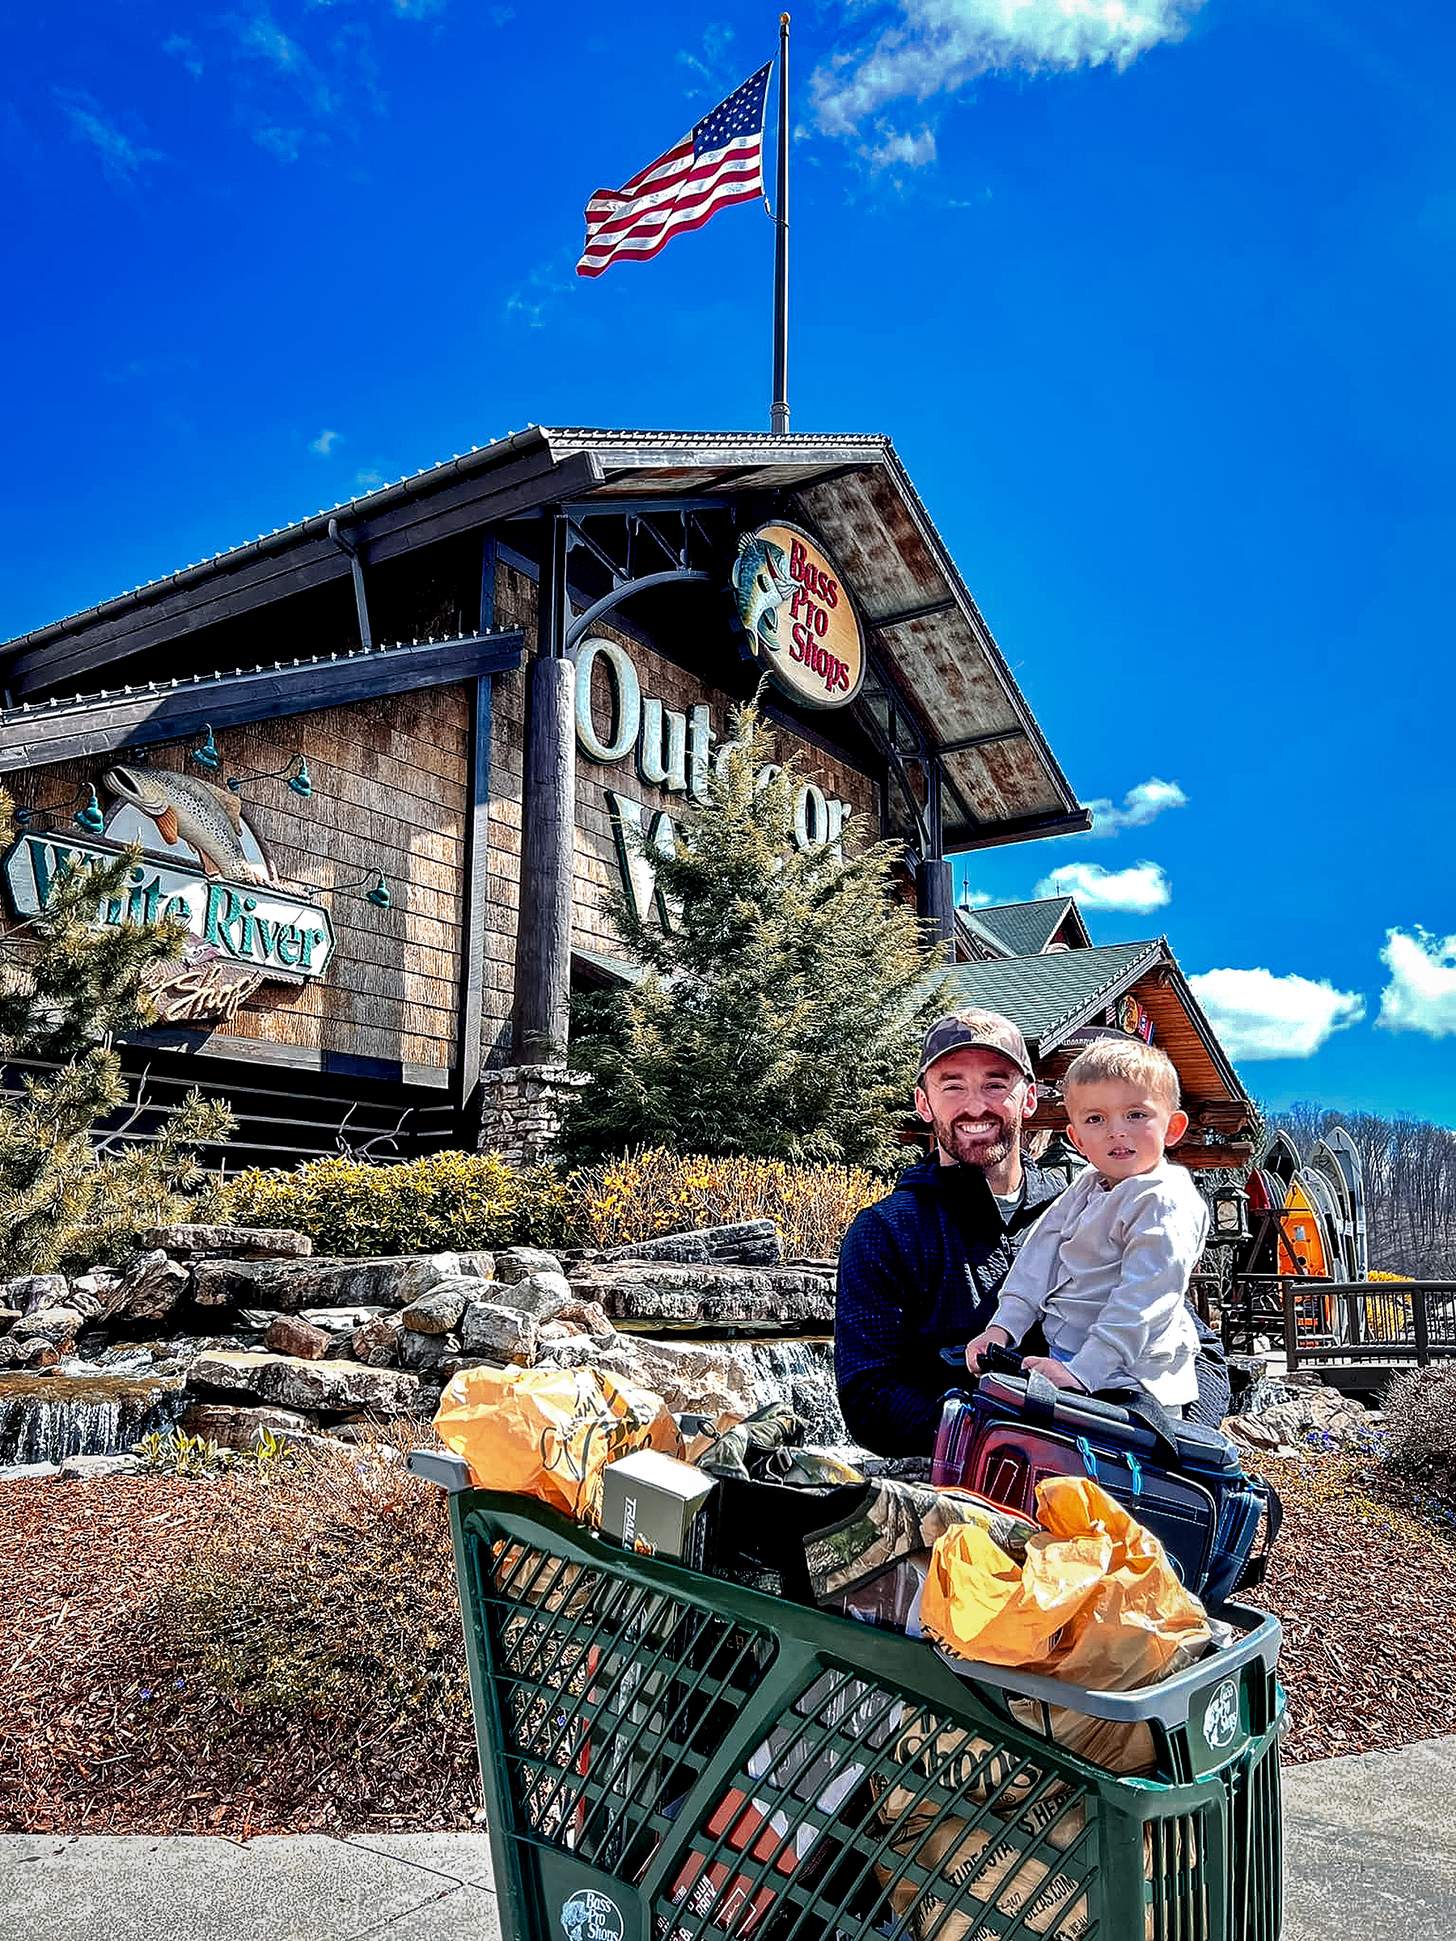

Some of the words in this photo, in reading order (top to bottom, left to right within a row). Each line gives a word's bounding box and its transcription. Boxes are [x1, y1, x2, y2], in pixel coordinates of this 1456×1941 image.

[789, 539, 839, 610] Bass
[788, 584, 830, 638] Pro
[788, 622, 850, 693] Shops
[24, 838, 193, 927] Wite
[203, 884, 325, 968] River
[586, 1892, 613, 1913] Bass
[587, 1909, 607, 1926] Pro
